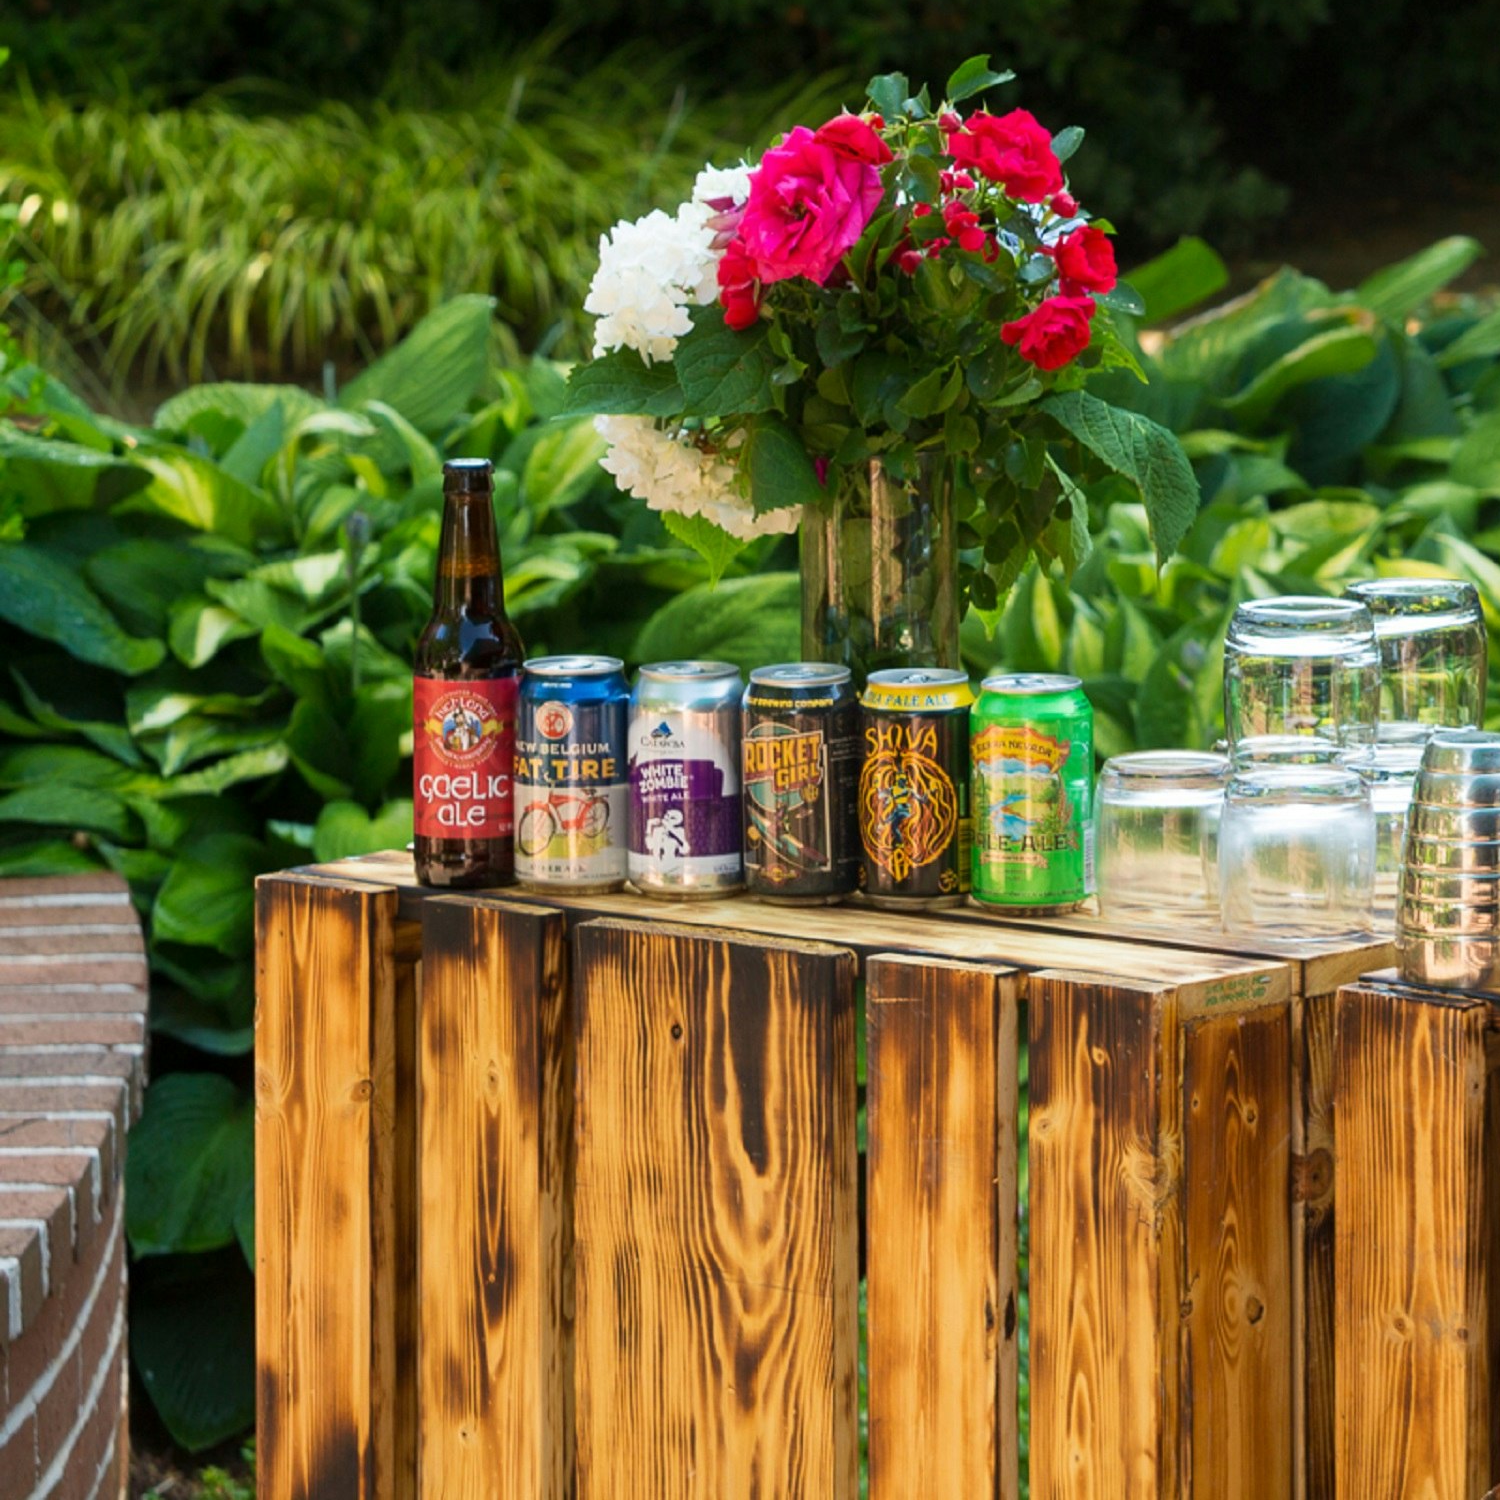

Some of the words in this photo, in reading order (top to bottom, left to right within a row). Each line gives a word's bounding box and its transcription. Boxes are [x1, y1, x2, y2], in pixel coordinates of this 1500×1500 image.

[540, 742, 610, 755] BELGIUM
[864, 723, 938, 758] SHIVA
[744, 734, 820, 773] ROCKET
[551, 758, 616, 780] TIRE
[640, 763, 684, 779] WHITE
[776, 762, 819, 789] GIRL
[638, 775, 689, 794] ZOMBIE
[1021, 833, 1067, 851] ALE
